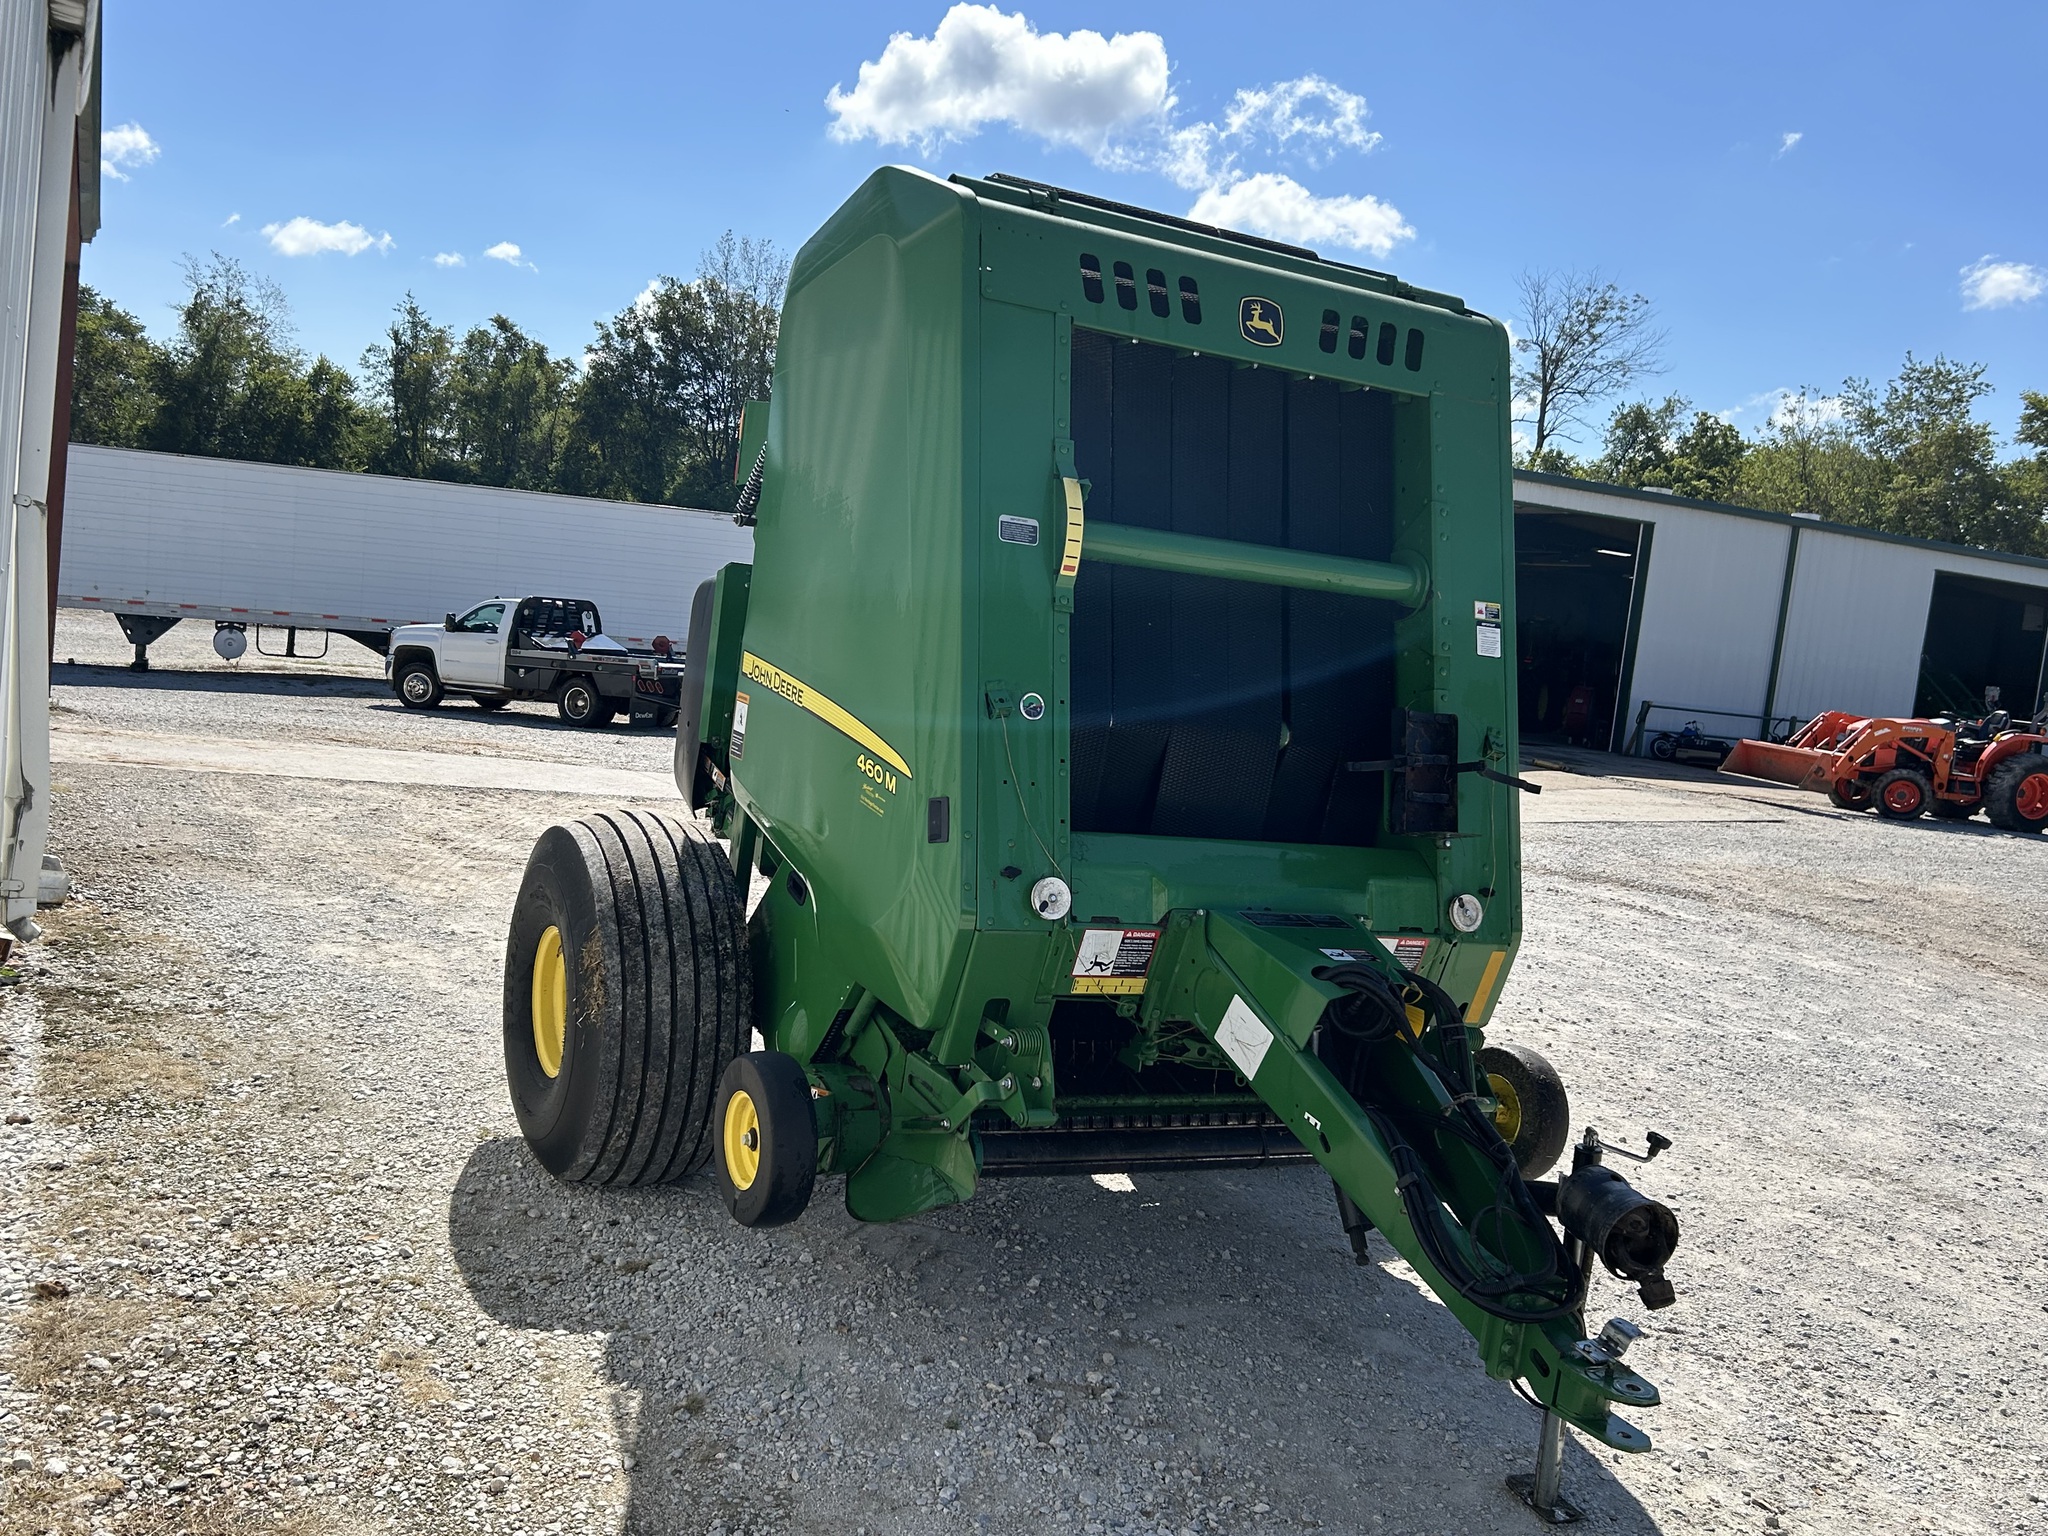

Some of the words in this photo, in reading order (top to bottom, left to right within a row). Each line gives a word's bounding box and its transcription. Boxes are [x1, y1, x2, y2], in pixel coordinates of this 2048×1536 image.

[748, 660, 772, 687] JOHN
[773, 672, 804, 705] DEERE
[856, 753, 884, 784] 460
[885, 771, 897, 795] M
